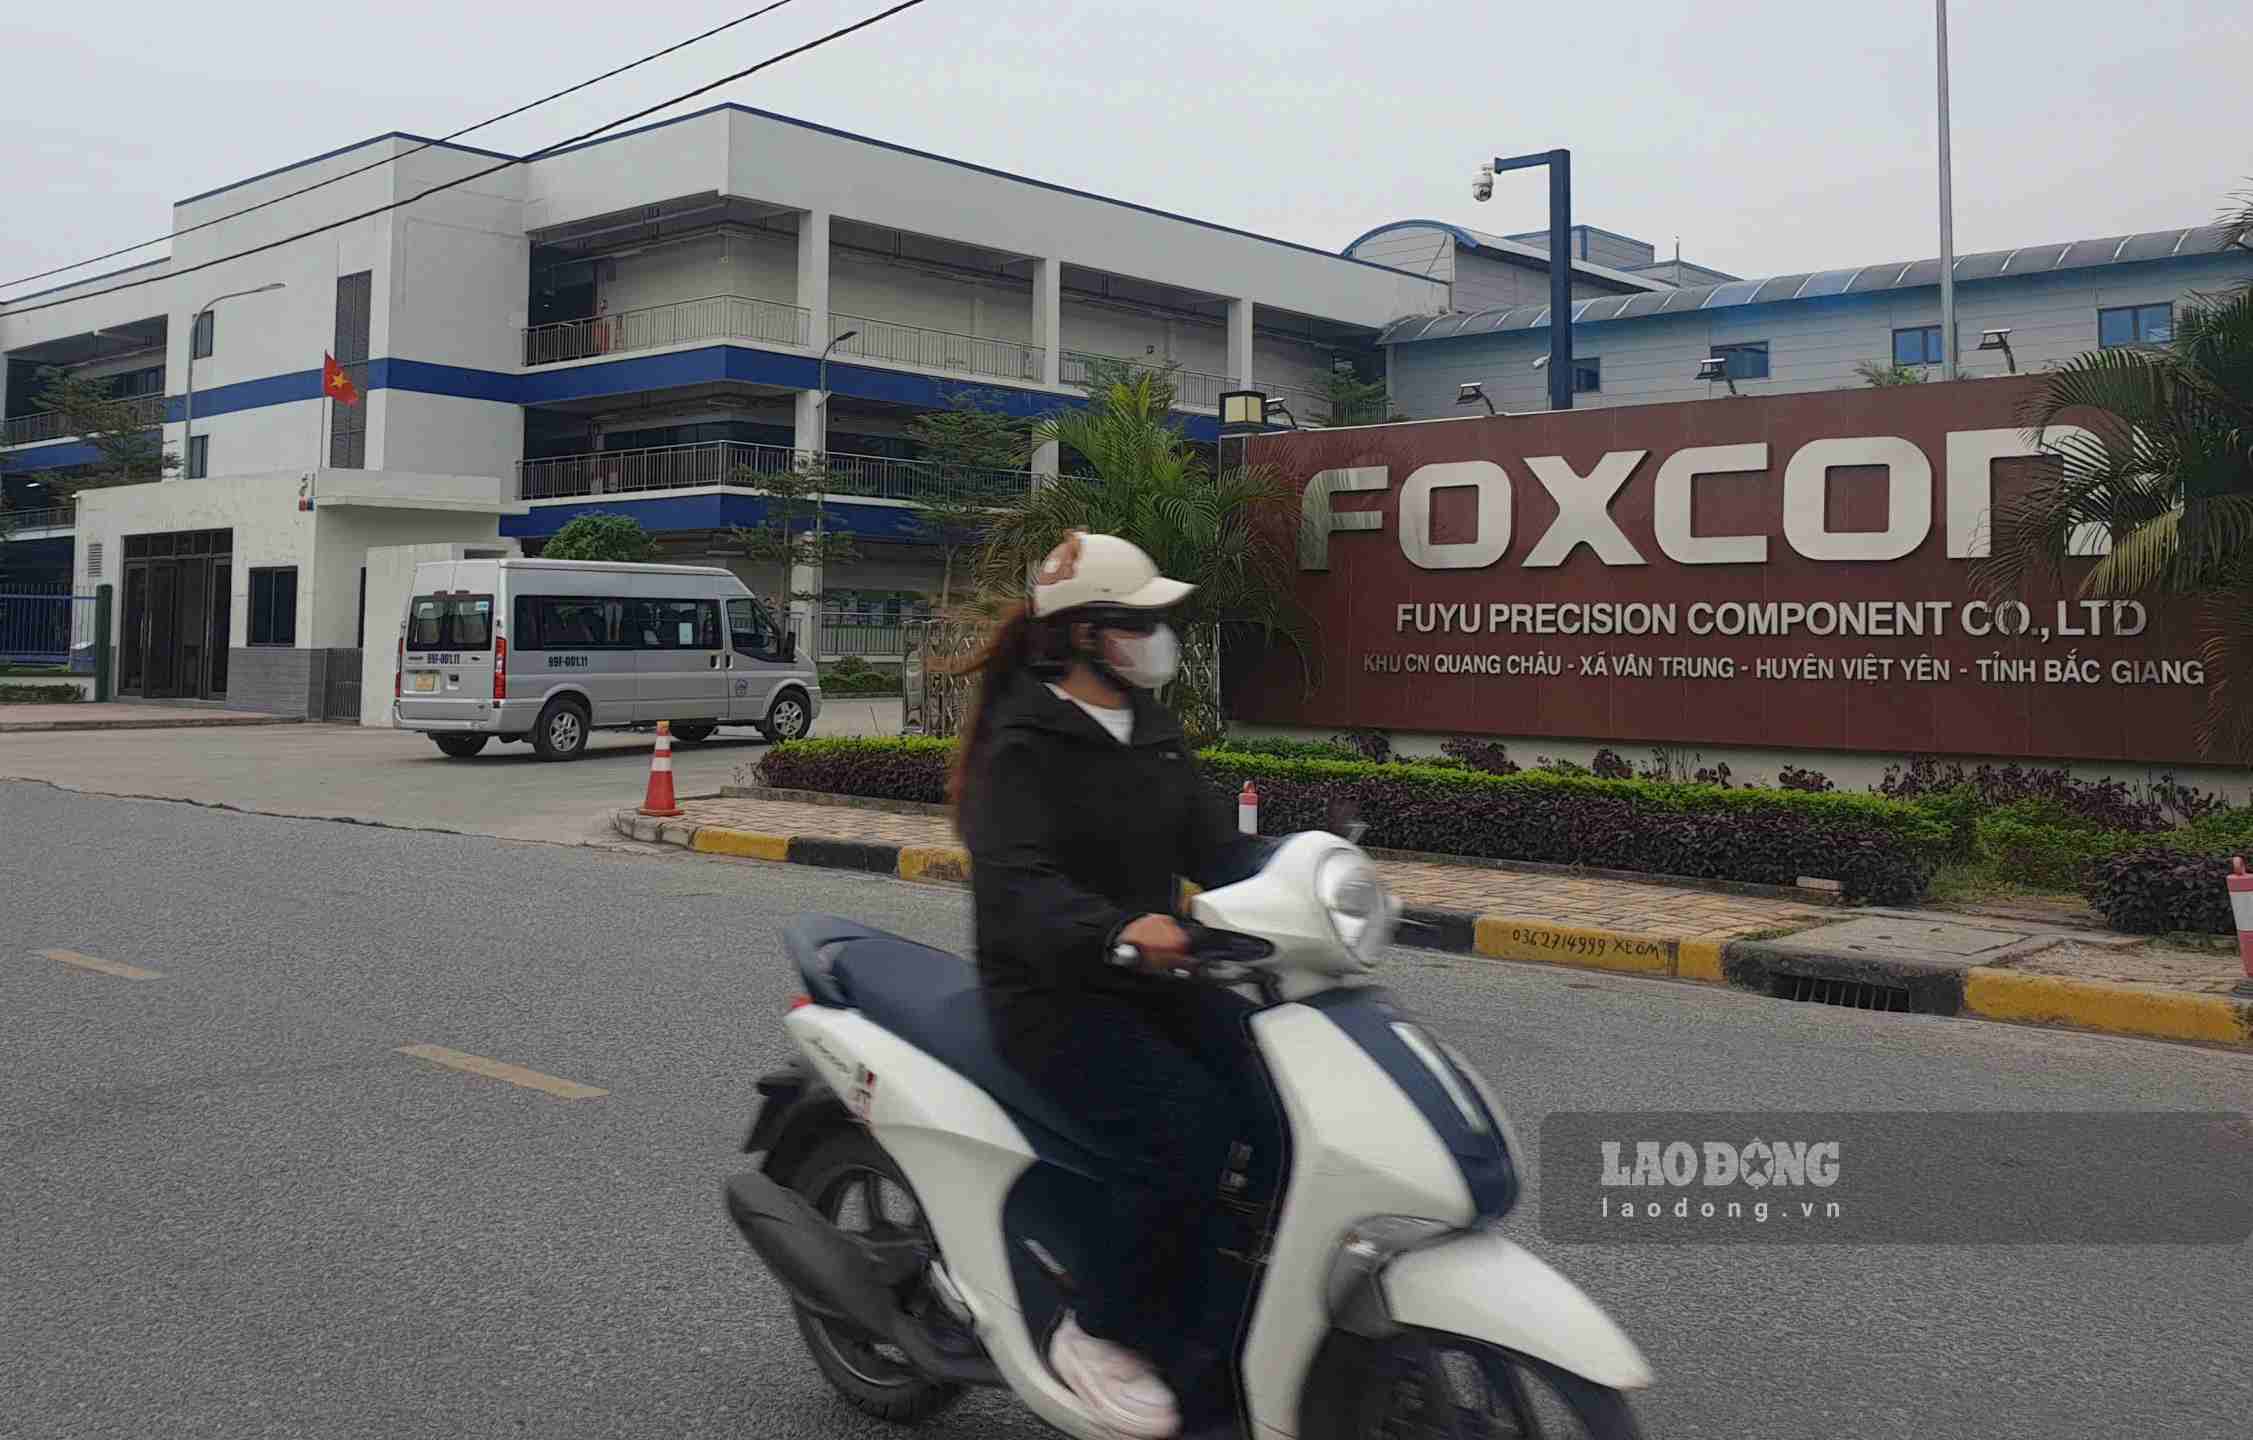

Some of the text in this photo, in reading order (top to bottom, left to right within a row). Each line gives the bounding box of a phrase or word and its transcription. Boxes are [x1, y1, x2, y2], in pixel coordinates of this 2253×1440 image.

[1301, 424, 2185, 572] FOXCON
[1398, 603, 1480, 632] FUYU
[1490, 603, 1675, 634] PRECISION
[1688, 602, 1952, 635] COMPONENT
[1365, 656, 1400, 672] KHU
[1405, 654, 1429, 672] CN
[1435, 654, 1500, 673] QUANG
[1507, 651, 1560, 675] CHÂU
[1612, 654, 1652, 676] VÂN
[1659, 657, 1733, 677] TRUNG
[1841, 653, 1893, 684] VIỆT
[1901, 654, 1949, 680] YÊN
[1976, 651, 2035, 682] TỈNH
[2044, 648, 2100, 682] BẮC
[2112, 661, 2203, 684] GIANG
